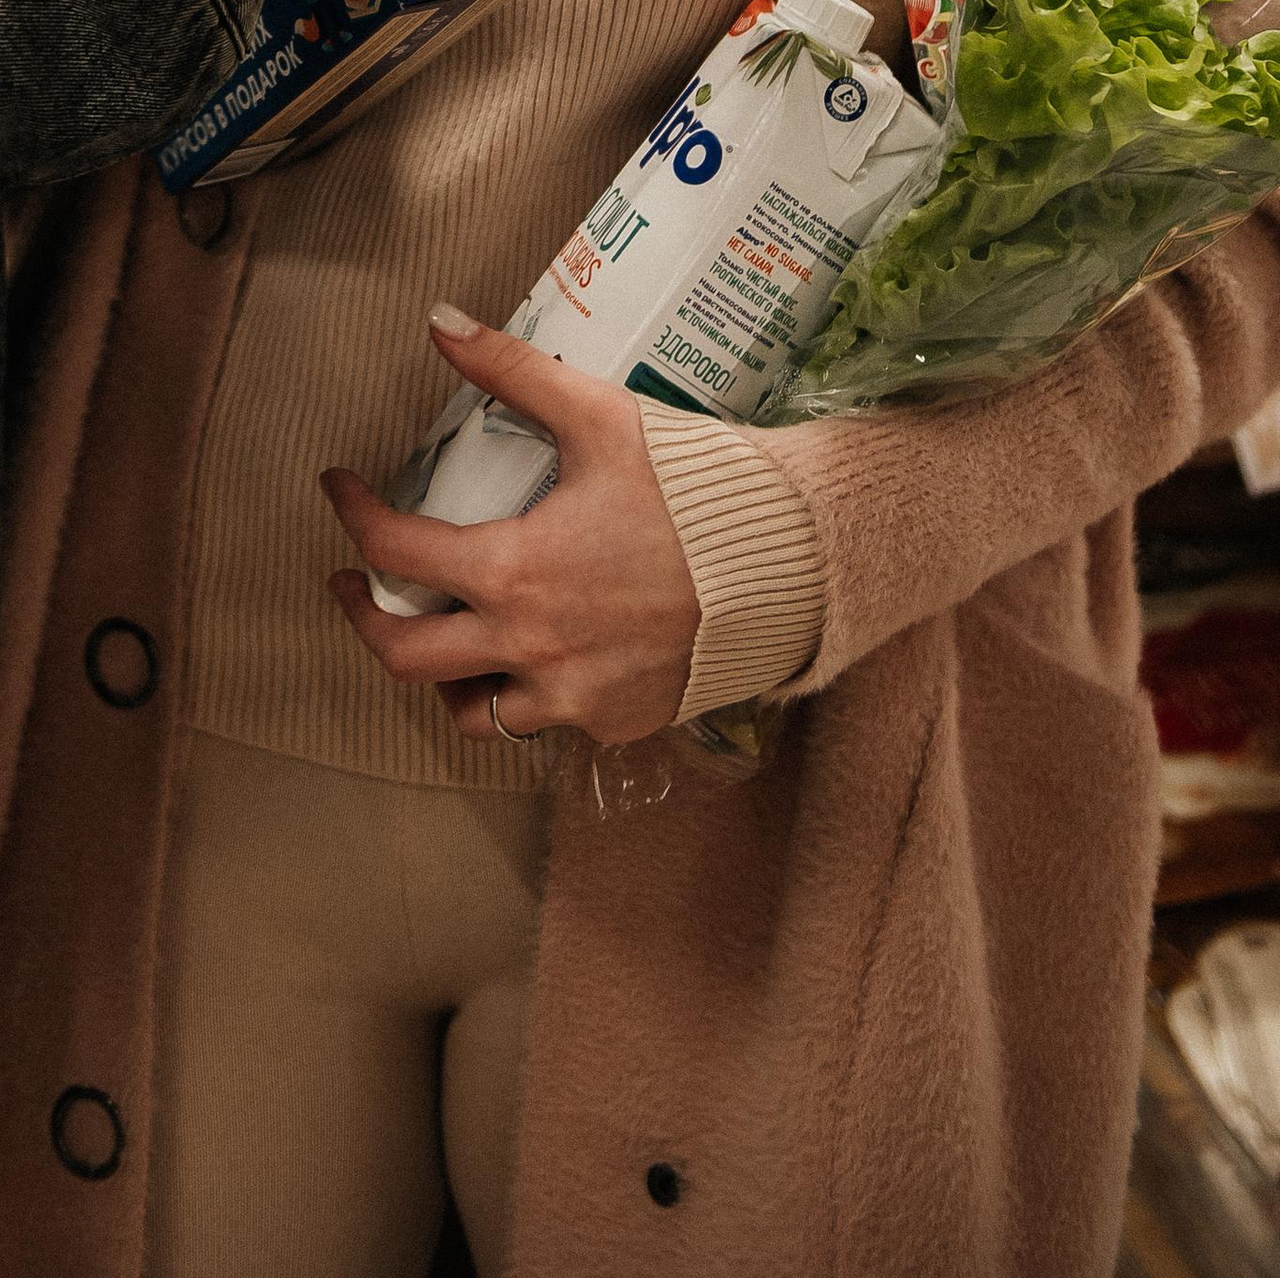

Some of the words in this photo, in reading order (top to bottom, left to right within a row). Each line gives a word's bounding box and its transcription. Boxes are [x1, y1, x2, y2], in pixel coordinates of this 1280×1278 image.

[225, 35, 303, 120] ПОДАРОК
[639, 75, 723, 185] lpro
[752, 218, 795, 252] кокосовом
[760, 190, 827, 244] НАСЛАЖДАТЬСЯ
[824, 236, 855, 263] КОКОСО
[769, 181, 800, 207] Ничего
[799, 205, 811, 216] не
[810, 213, 843, 239] должно
[726, 235, 747, 255] НЕТ
[764, 242, 780, 259] NO
[791, 232, 823, 259] Именно
[709, 260, 773, 313] ТРОПИЧЕСКОГО
[718, 251, 745, 275] Только
[746, 267, 782, 299] ЧИСТЫЙ
[778, 292, 799, 311] ВКУС
[676, 304, 733, 350] ИСТОЧНИКОМ
[691, 287, 702, 298] на
[701, 295, 754, 335] растительной
[691, 300, 726, 329] является
[698, 277, 716, 294] Наш
[715, 289, 758, 323] кокосовый
[756, 316, 791, 346] НАПИТОК
[653, 324, 738, 398] ЗДОРОВО!
